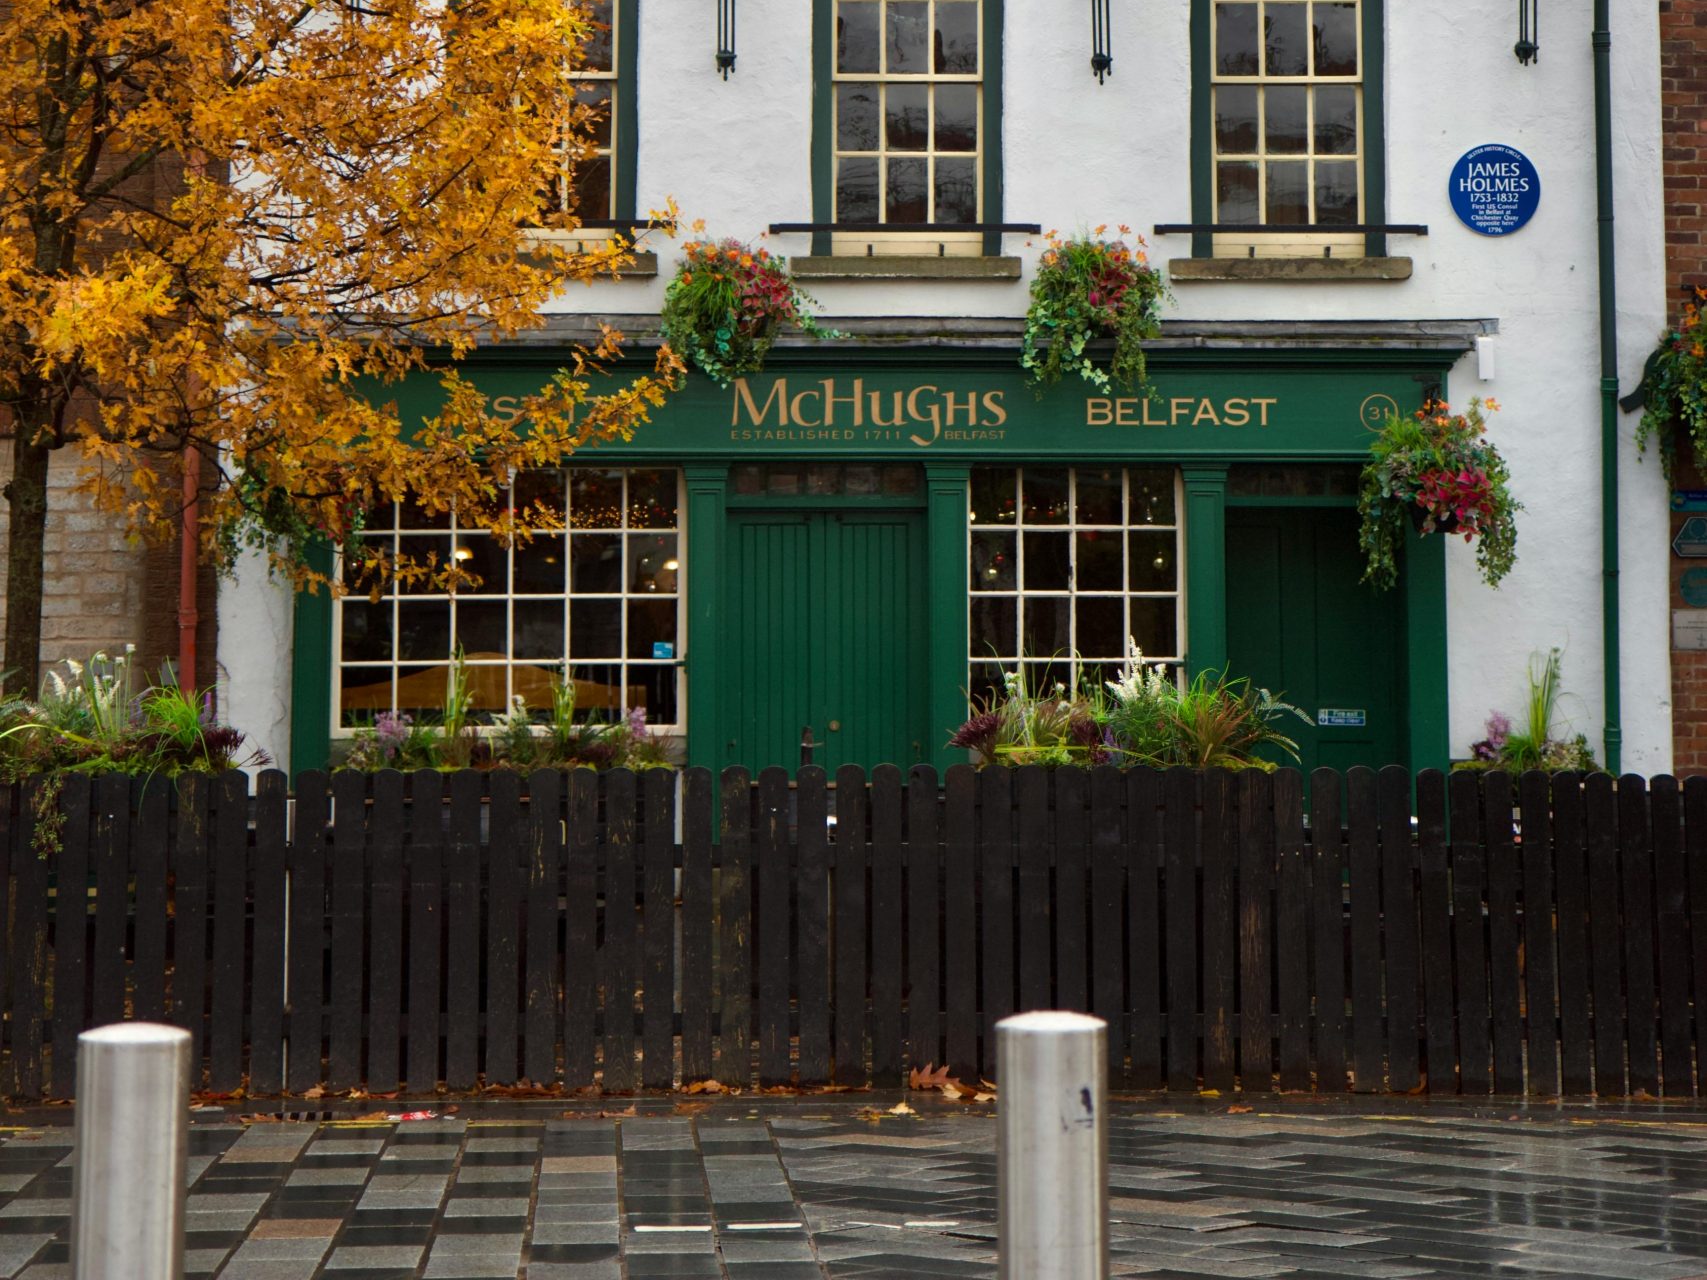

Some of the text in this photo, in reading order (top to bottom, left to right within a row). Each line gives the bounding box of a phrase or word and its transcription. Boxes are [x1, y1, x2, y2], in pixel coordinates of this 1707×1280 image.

[1469, 163, 1520, 178] JAMES
[1460, 178, 1529, 191] HOLMES
[1470, 193, 1519, 202] 1753-1832
[1086, 397, 1278, 426] BELFAST
[1369, 406, 1389, 420] 31
[731, 430, 1006, 441] ESTABLISHED 1711 BELFAST
